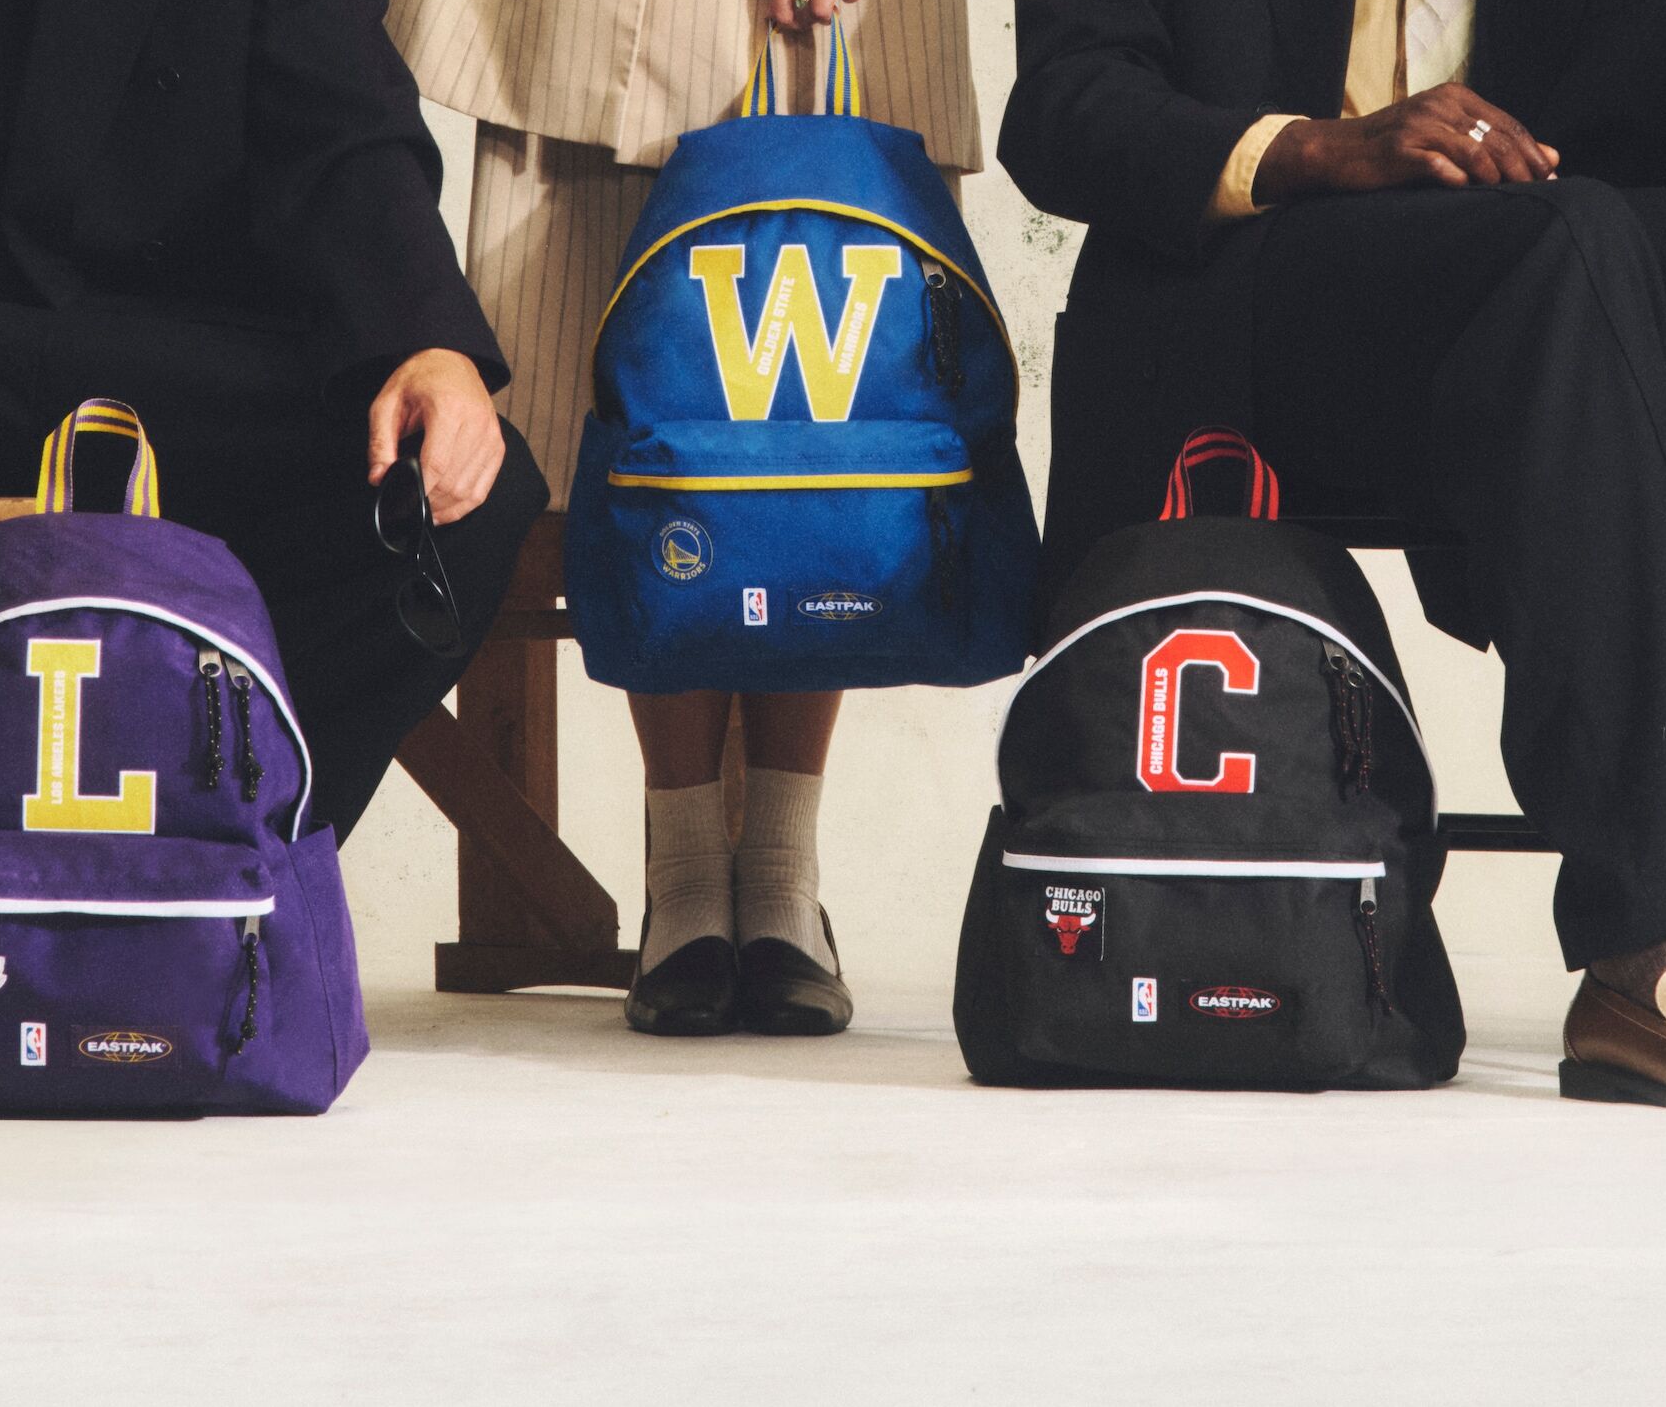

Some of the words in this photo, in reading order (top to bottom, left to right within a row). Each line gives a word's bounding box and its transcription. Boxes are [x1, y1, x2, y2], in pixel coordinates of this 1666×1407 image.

[689, 244, 902, 423] W
[756, 320, 783, 376] GOLDEN
[772, 275, 796, 318] STATE
[837, 301, 868, 375] WARRIORS
[663, 561, 706, 581] WARRIORS
[805, 601, 874, 612] EASTPAK
[52, 670, 66, 720] LAKERS
[1136, 628, 1260, 794] C
[1152, 667, 1169, 712] BULLS
[23, 638, 158, 835] L
[1149, 715, 1166, 775] CHICAGO
[51, 781, 64, 805] LOS
[1045, 886, 1102, 903] CHICAGO
[1051, 898, 1093, 915] BULLS
[1198, 996, 1272, 1009] EASTPAK
[87, 1041, 163, 1053] EASTPAK
